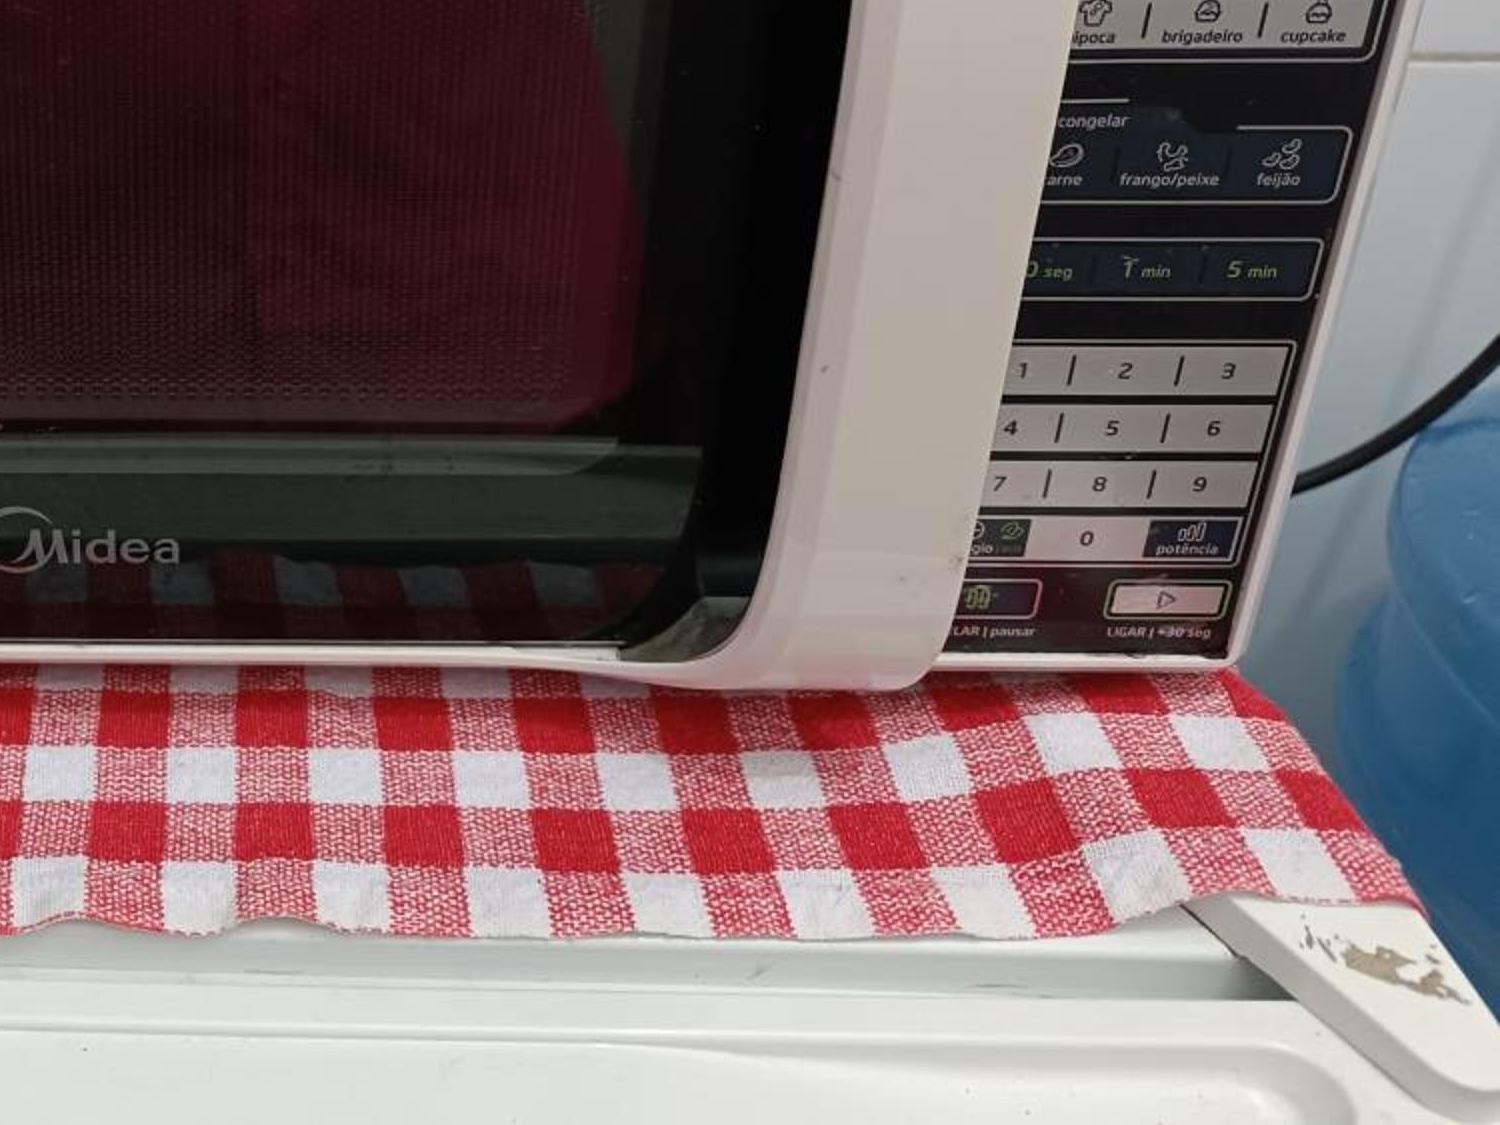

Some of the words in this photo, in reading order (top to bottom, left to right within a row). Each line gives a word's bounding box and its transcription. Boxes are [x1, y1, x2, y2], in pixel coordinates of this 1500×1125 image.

[1162, 29, 1243, 45] brigadeiro
[1280, 29, 1346, 46] cupcake
[1057, 112, 1130, 130] congelar
[1046, 175, 1083, 186] arne
[1119, 172, 1220, 188] frango/peixe
[1256, 172, 1300, 188] feijão
[1044, 266, 1073, 281] seg
[1141, 264, 1171, 278] min
[1227, 261, 1243, 278] 5
[1247, 264, 1277, 278] min
[1015, 362, 1029, 378] 1
[1117, 362, 1133, 379] 2
[1221, 362, 1237, 379] 3
[1003, 420, 1018, 436] 4
[1104, 420, 1120, 436] 5
[1207, 420, 1222, 436] 6
[992, 477, 1006, 492] 7
[1092, 477, 1108, 492] 8
[1193, 477, 1207, 492] 9
[0, 521, 180, 568] Midea
[1079, 531, 1094, 547] 0
[1156, 542, 1219, 556] potência
[990, 627, 1036, 639] pausar
[1107, 626, 1148, 638] LIGAR
